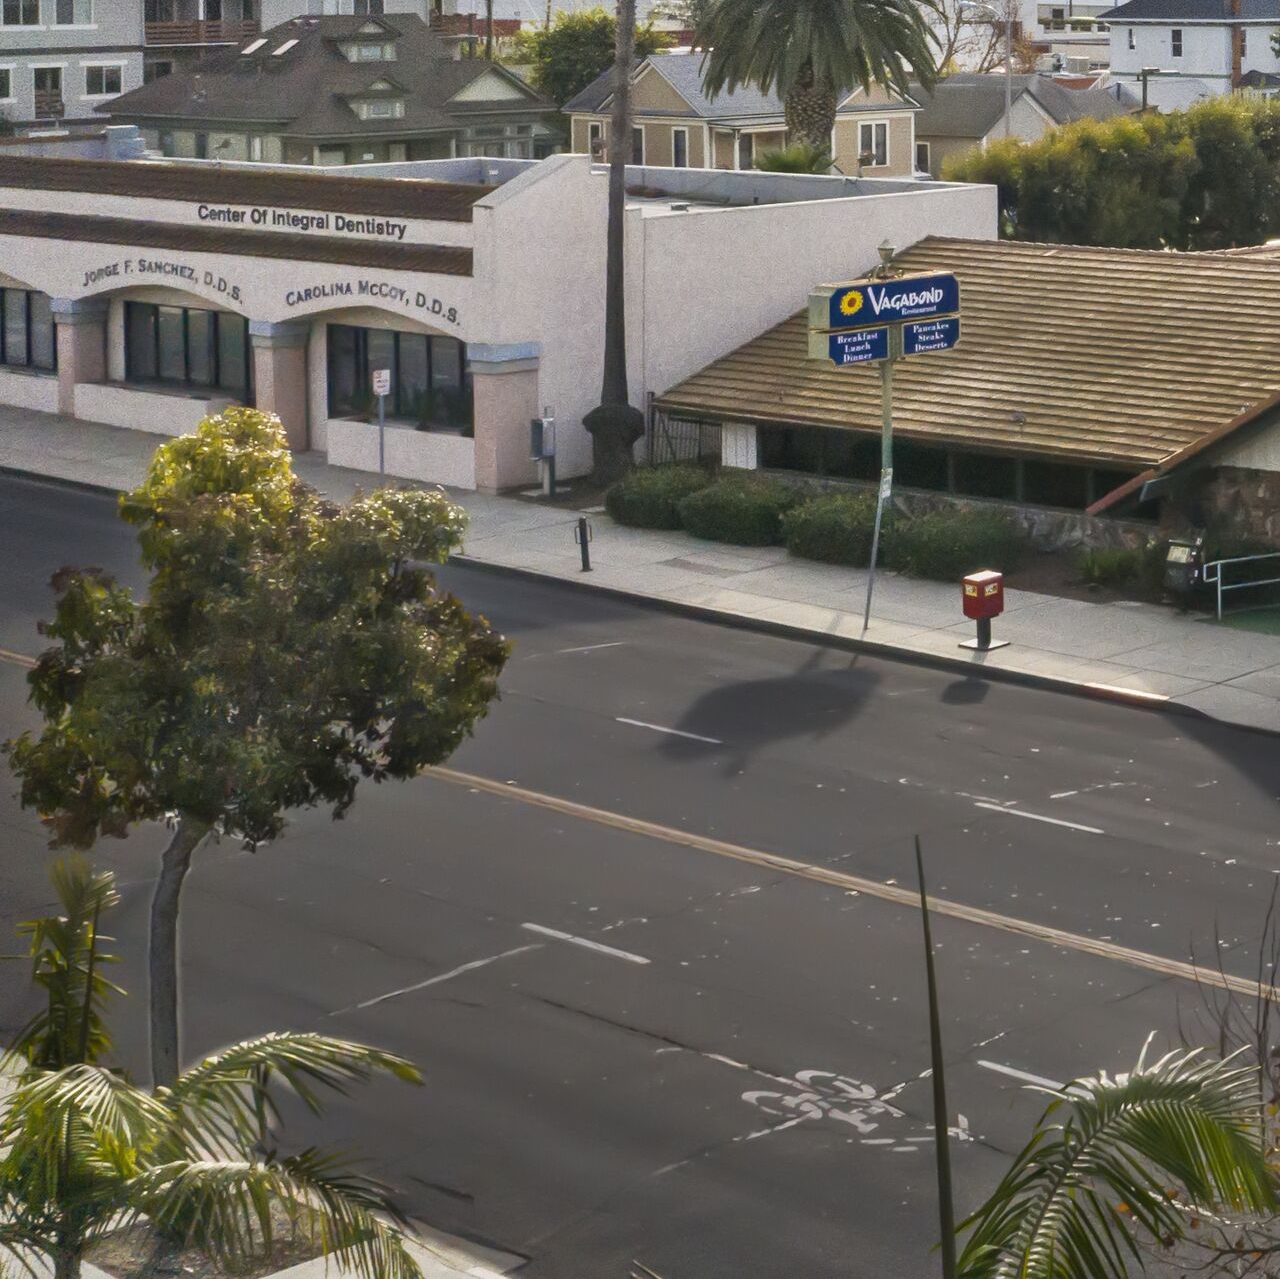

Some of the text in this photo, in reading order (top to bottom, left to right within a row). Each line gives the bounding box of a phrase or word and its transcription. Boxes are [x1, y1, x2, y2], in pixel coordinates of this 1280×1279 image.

[198, 205, 407, 240] Center Of Integral Dentistry
[83, 259, 244, 305] JORGE F. SANCHEZ, D.D.S.
[285, 282, 353, 307] CAROLINA
[415, 292, 461, 326] D.D.S.
[867, 286, 944, 316] VAGABOND
[901, 305, 937, 316] Restaurant
[913, 322, 950, 333] Pancakes
[837, 331, 878, 344] Breakfast
[918, 332, 944, 342] Steaks
[845, 342, 871, 353] Lunch
[914, 342, 948, 353] Desserts
[843, 352, 873, 363] Dinner
